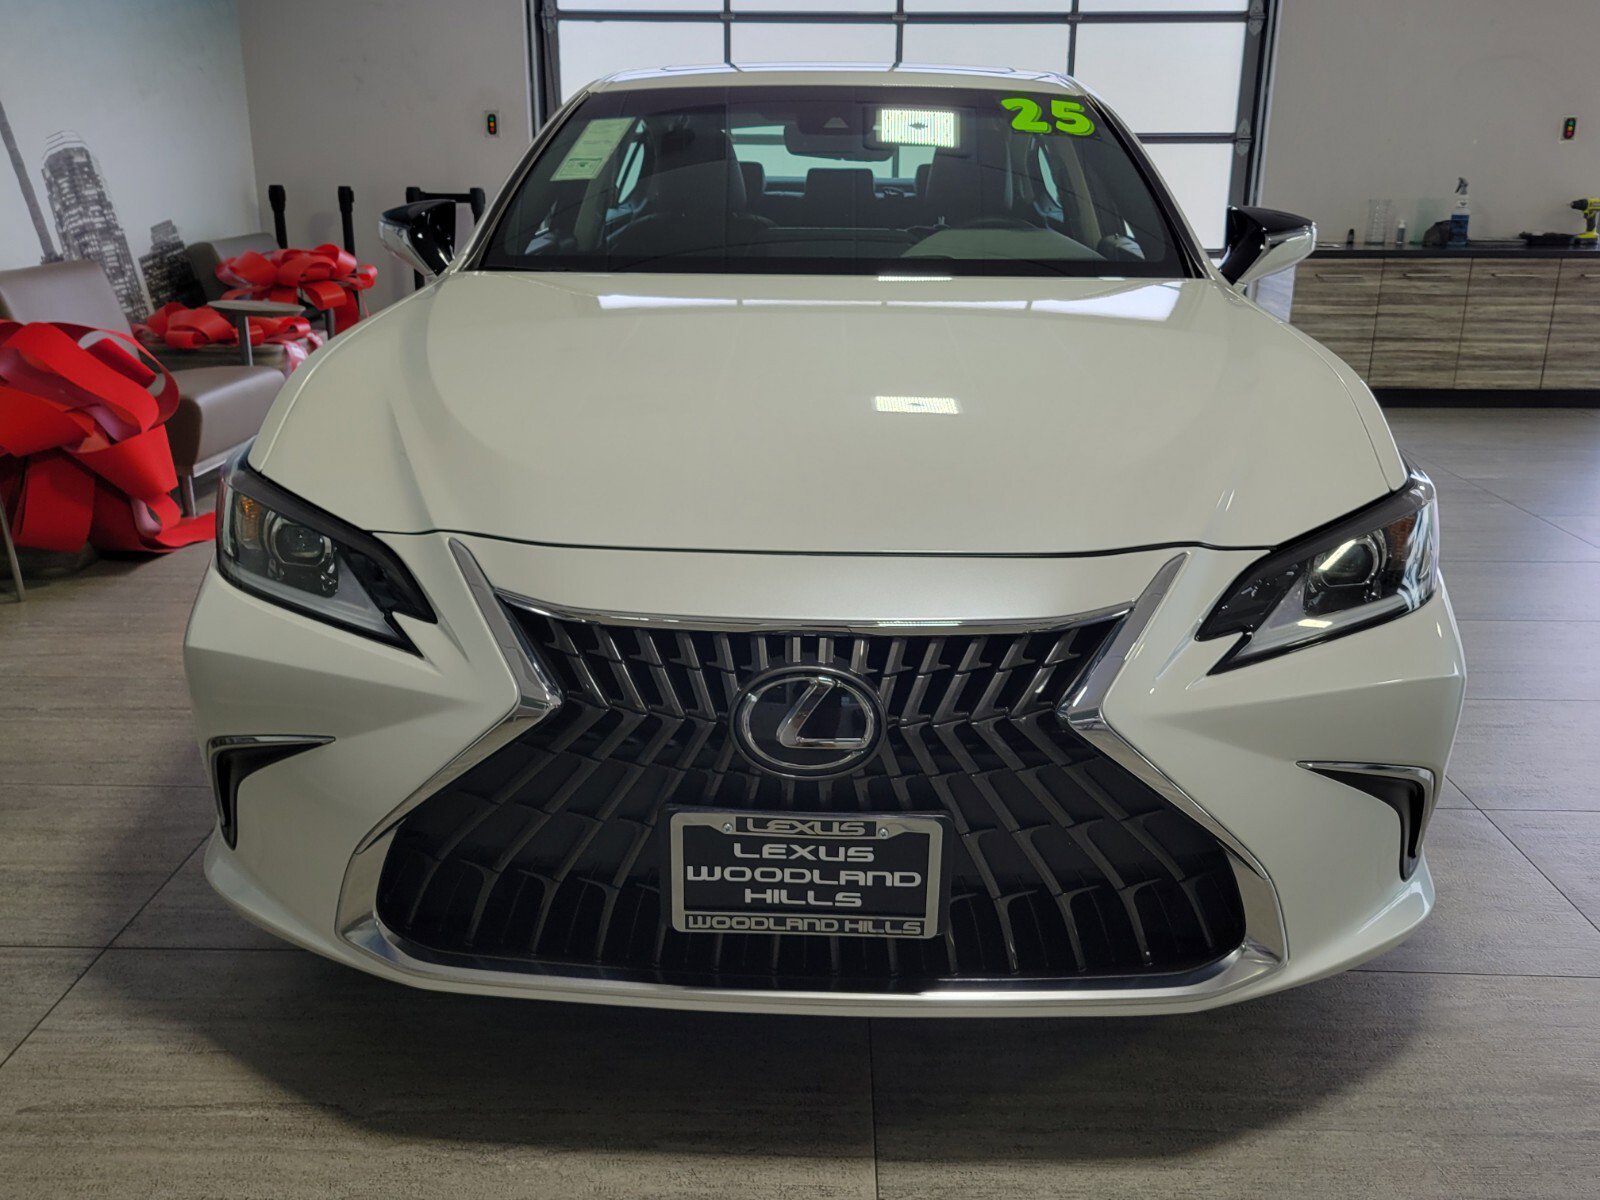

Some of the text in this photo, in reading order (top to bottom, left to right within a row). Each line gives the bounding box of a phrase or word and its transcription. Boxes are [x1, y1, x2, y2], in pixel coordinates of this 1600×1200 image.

[1001, 98, 1095, 136] 25
[746, 817, 866, 836] LEXUS
[733, 842, 875, 863] LEXUS
[686, 865, 922, 888] WOODLAND
[744, 888, 863, 908] HILLS
[688, 915, 922, 935] WOODLAND HILLS
